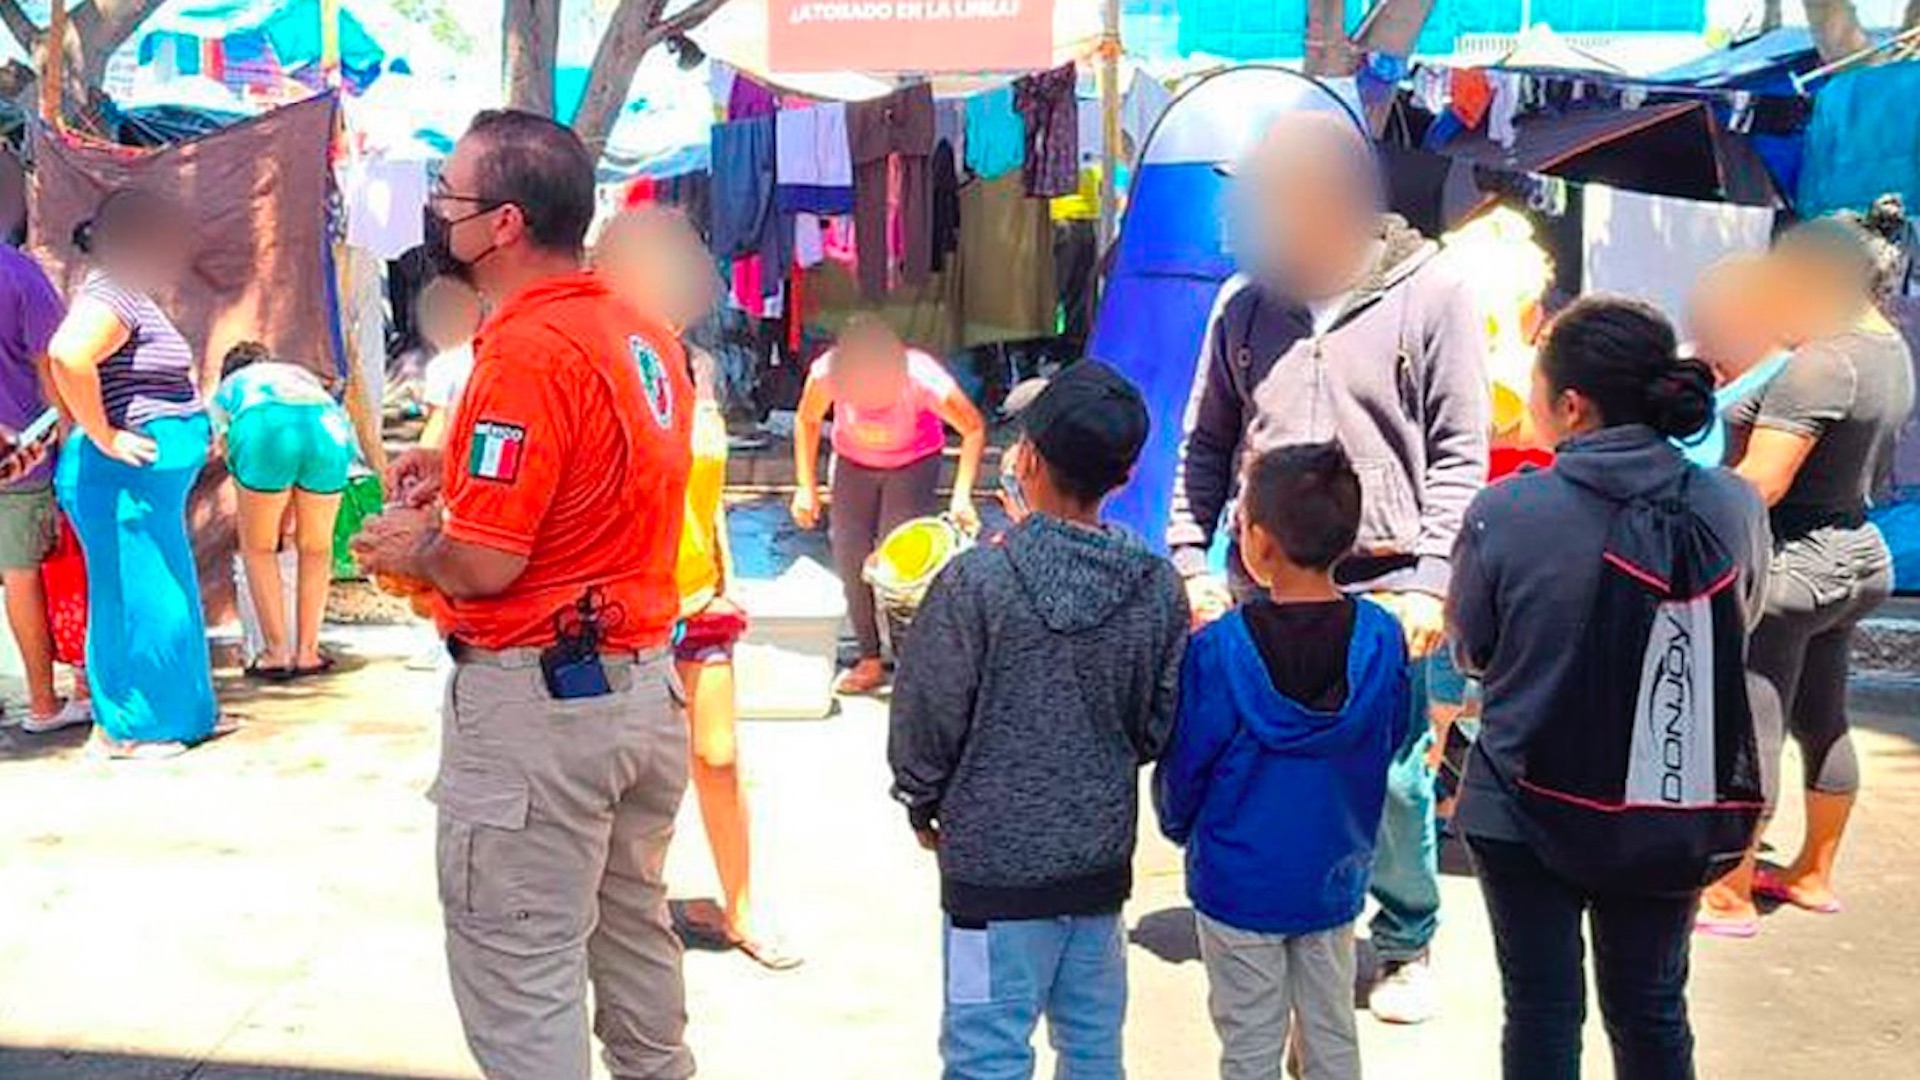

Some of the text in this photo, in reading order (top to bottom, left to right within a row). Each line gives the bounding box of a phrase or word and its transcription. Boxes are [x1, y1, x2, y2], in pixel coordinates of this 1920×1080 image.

[896, 3, 921, 21] EN
[926, 1, 951, 20] LA
[1661, 615, 1691, 803] DONJOY
